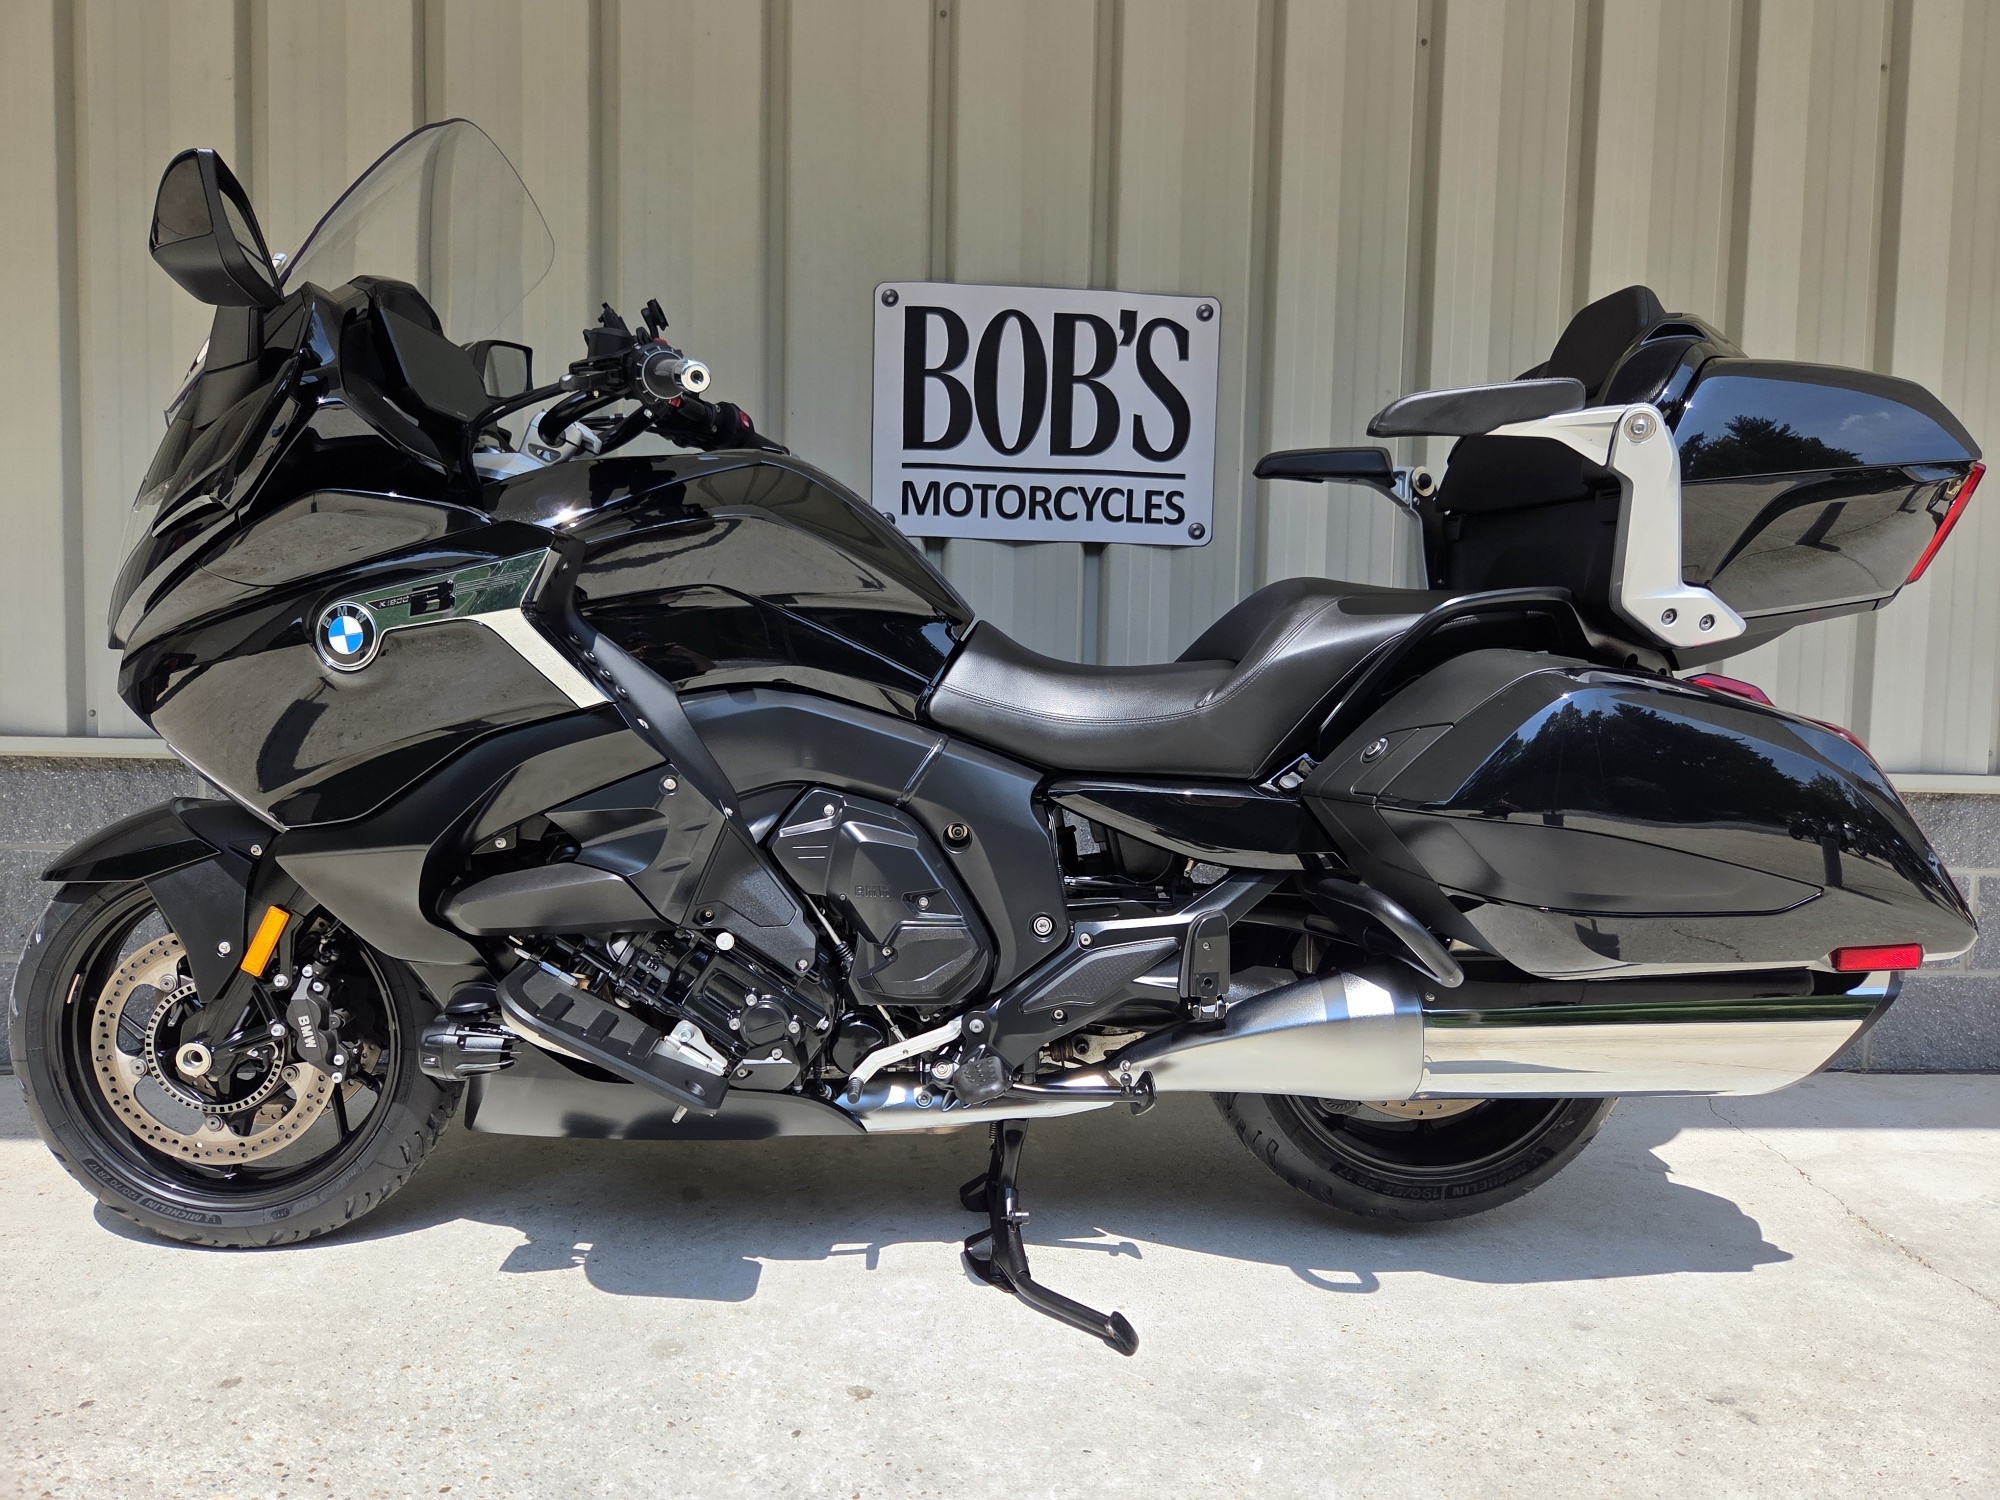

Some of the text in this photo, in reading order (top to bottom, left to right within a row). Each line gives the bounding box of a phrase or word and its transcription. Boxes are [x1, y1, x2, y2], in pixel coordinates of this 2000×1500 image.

[902, 305, 1191, 463] BOB'S
[901, 480, 1186, 526] MOTORCYCLES
[320, 605, 368, 629] BMW
[854, 885, 892, 898] BMW
[297, 1015, 317, 1048] BMW
[88, 1163, 203, 1221] MICHELIN 120/70 ZR 17
[1452, 1161, 1528, 1197] MICHELIN
